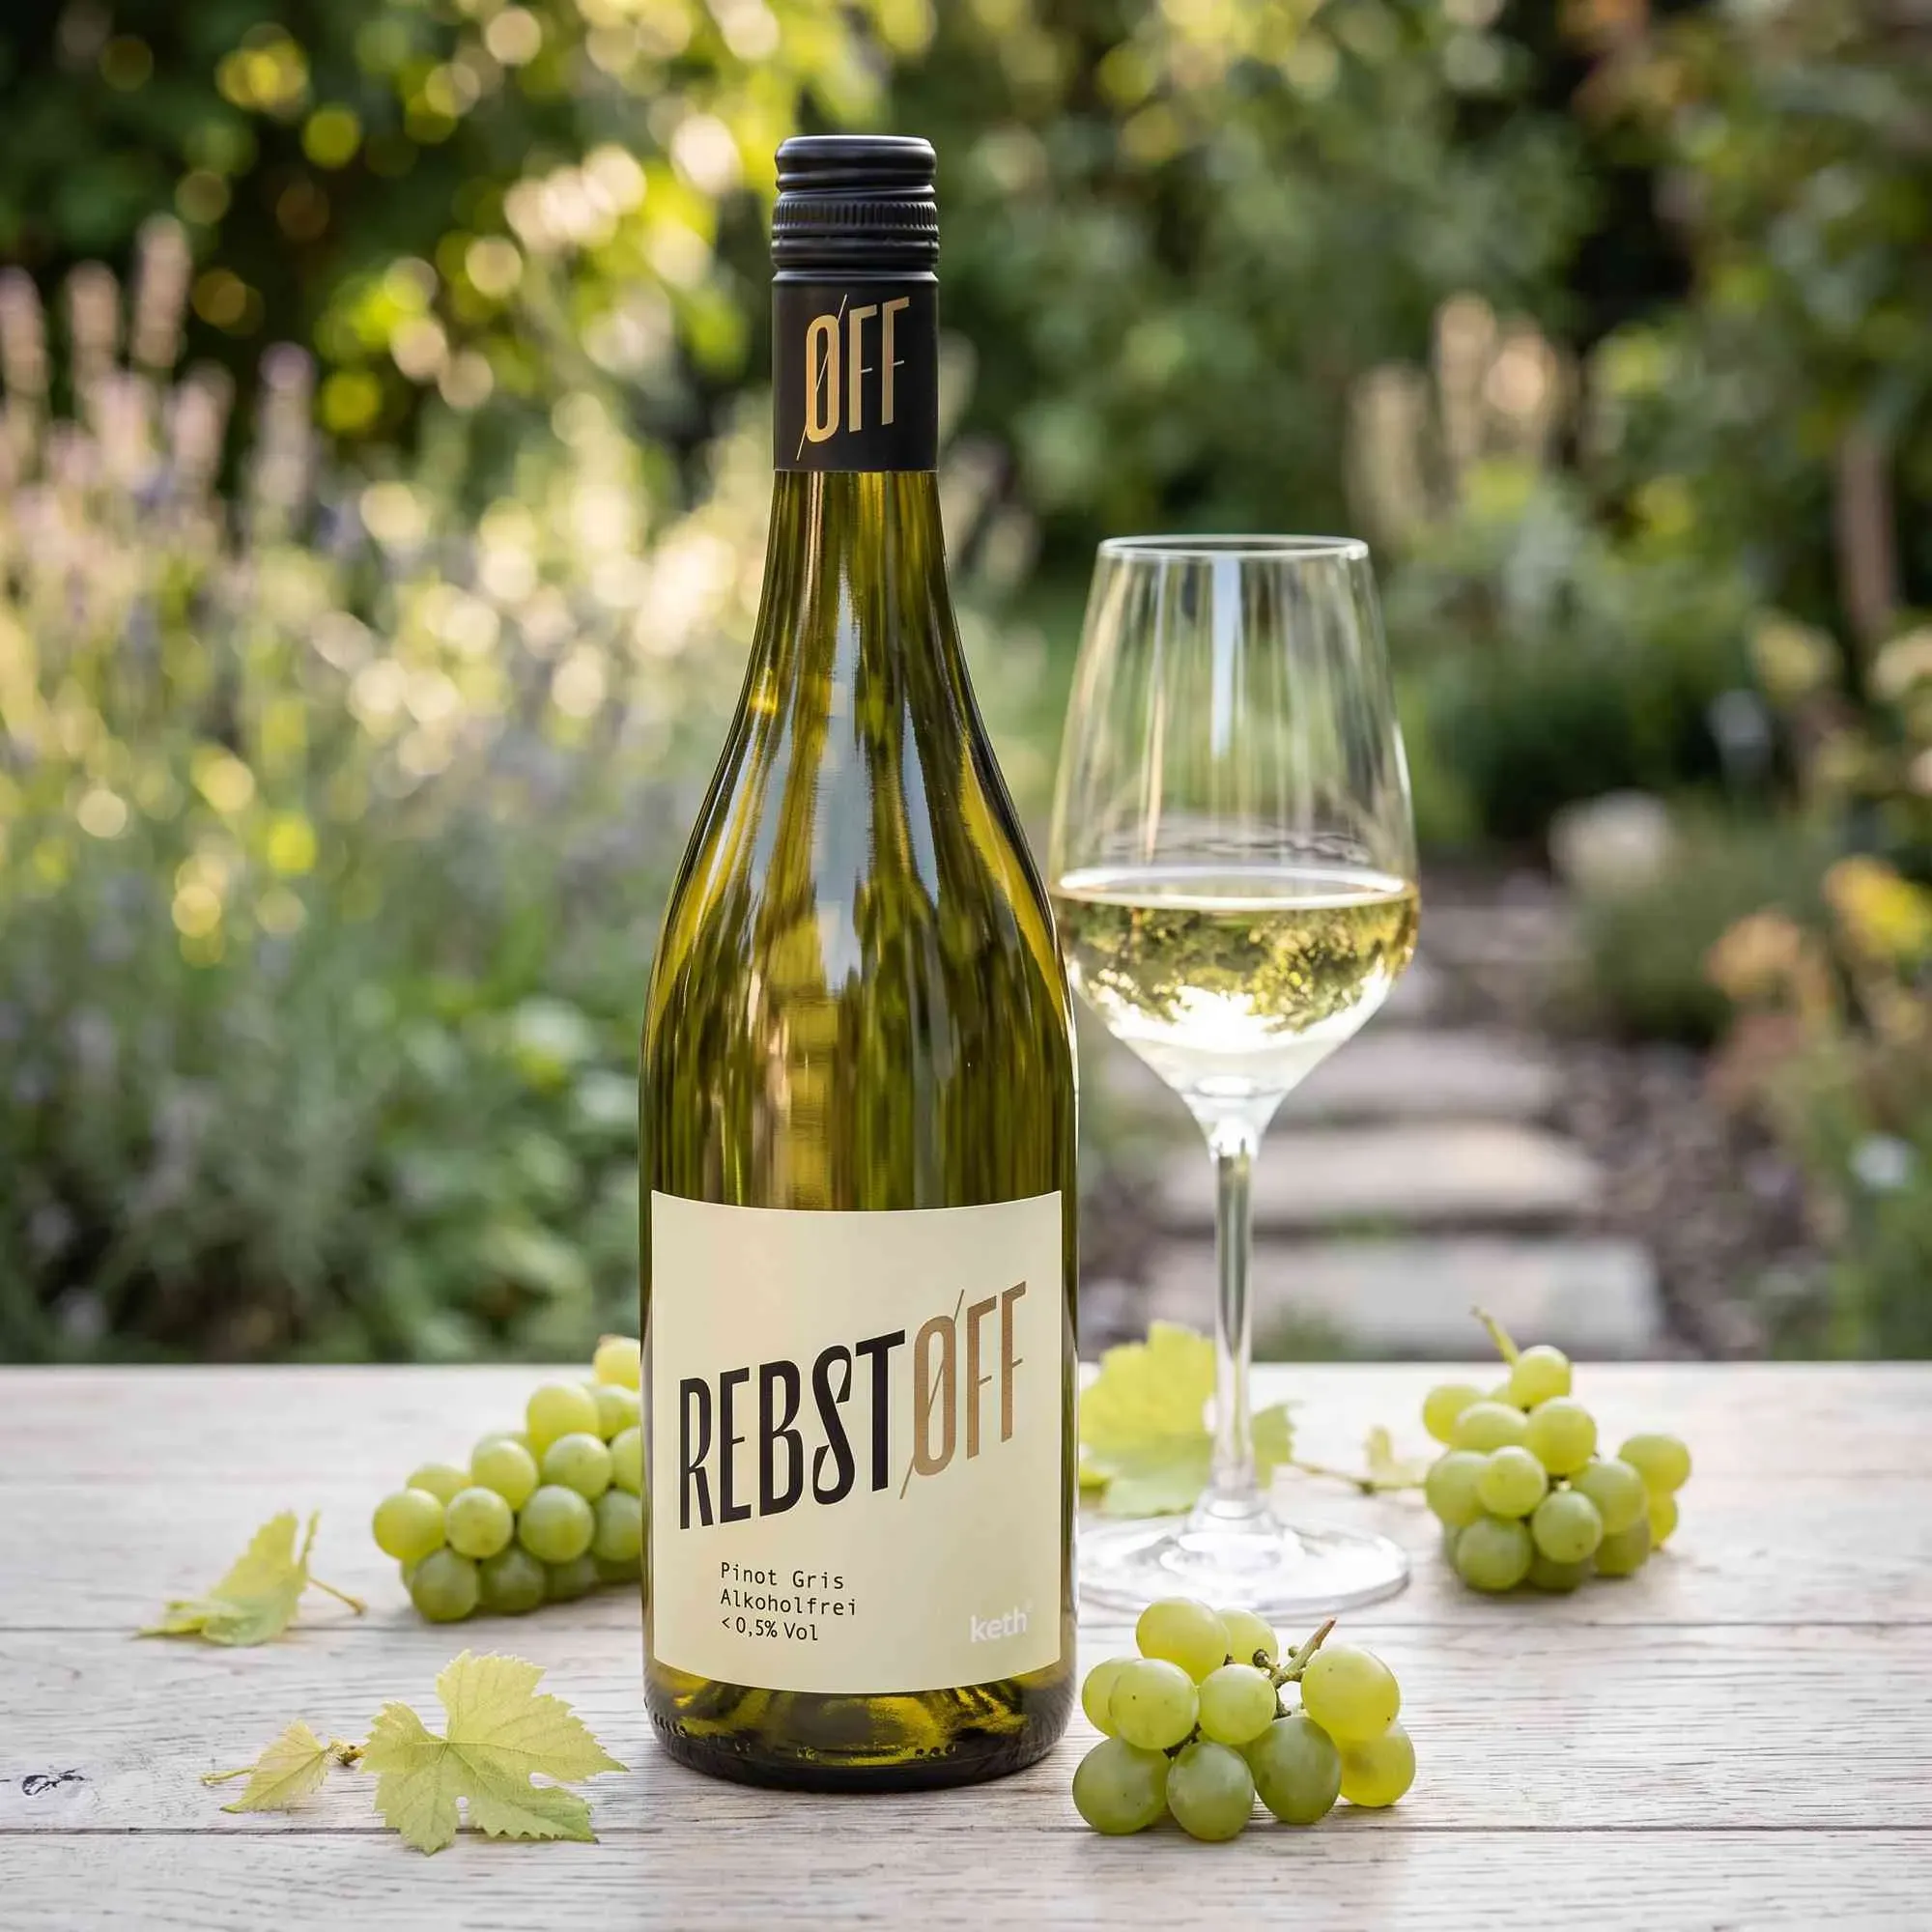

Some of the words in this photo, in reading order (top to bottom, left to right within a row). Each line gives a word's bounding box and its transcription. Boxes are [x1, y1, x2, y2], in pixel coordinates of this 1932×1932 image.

[721, 1561, 778, 1586] Pinot
[792, 1570, 844, 1590] Gris
[720, 1587, 856, 1616] Alkoholfrei
[783, 1622, 819, 1641] Vol
